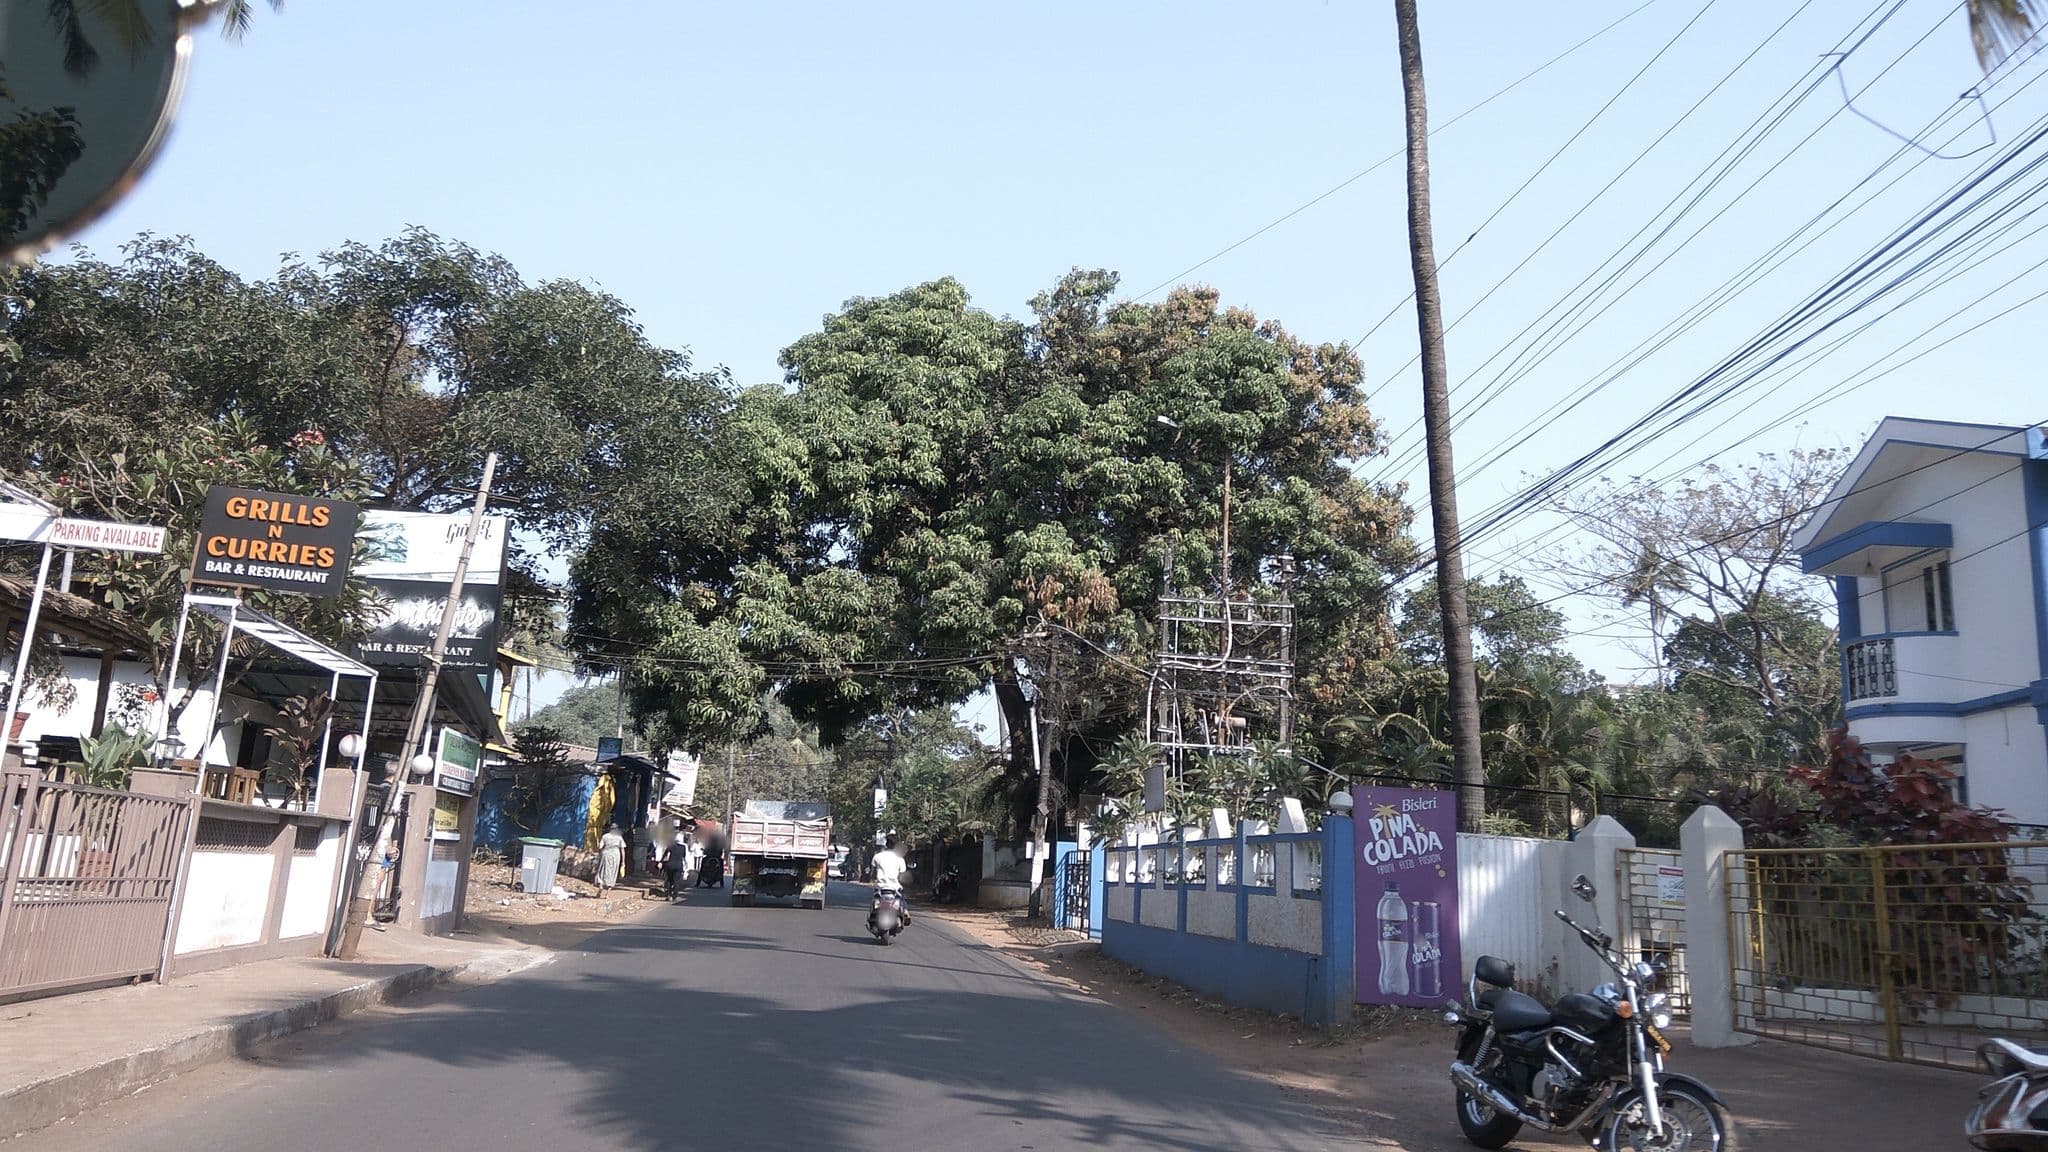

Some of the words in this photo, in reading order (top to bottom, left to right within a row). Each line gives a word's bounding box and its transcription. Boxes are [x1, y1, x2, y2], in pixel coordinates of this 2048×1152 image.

[226, 496, 331, 528] GRILLS
[54, 523, 100, 542] PARKING
[103, 527, 160, 549] AVAILABLE
[268, 524, 283, 539] N
[207, 535, 336, 569] CURRIES
[205, 560, 232, 574] BAR
[233, 563, 246, 576] &
[247, 565, 330, 585] RESTAURANT
[383, 642, 394, 653] &
[395, 643, 473, 657] RESTARANT
[1402, 796, 1437, 812] Bisleri
[1363, 830, 1444, 866] COLADA
